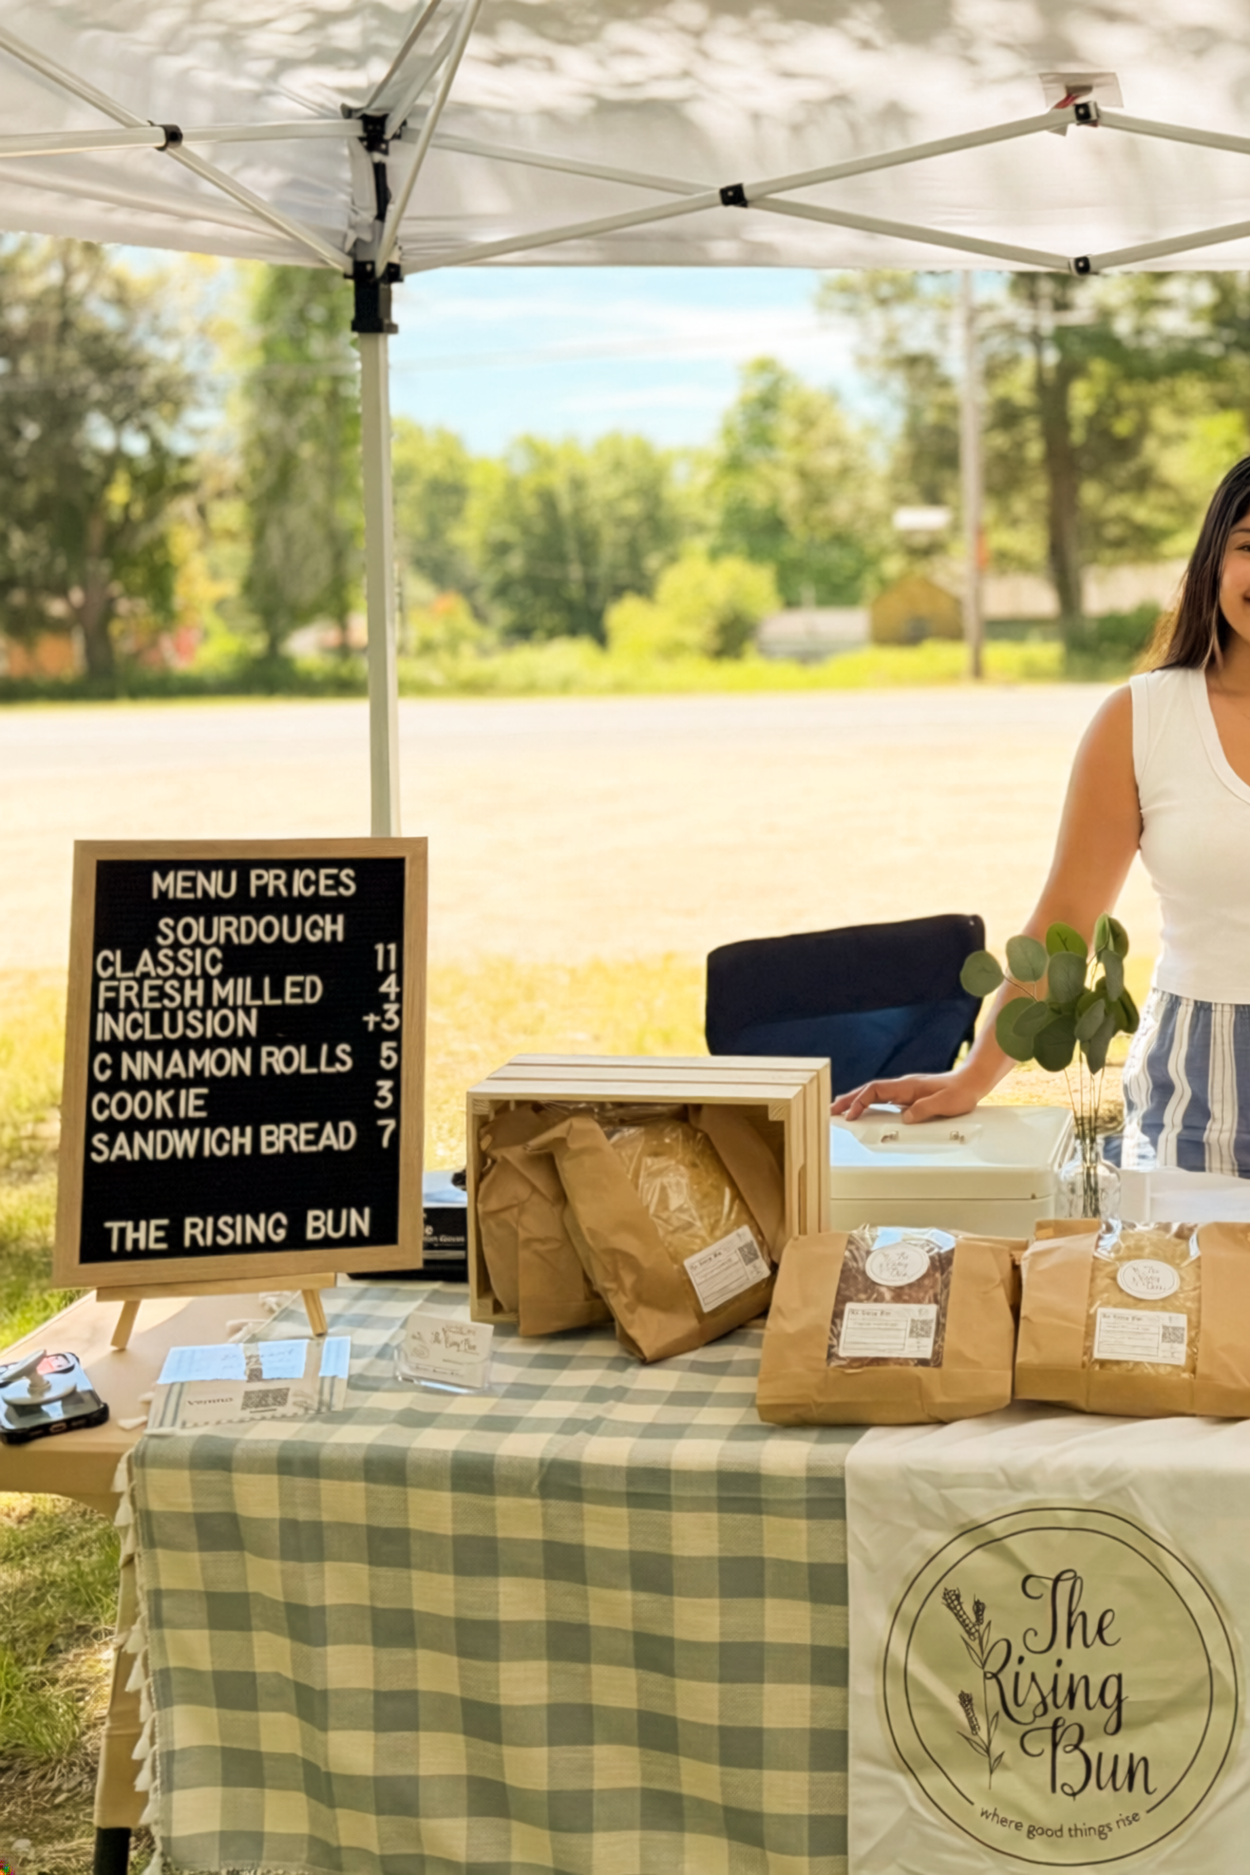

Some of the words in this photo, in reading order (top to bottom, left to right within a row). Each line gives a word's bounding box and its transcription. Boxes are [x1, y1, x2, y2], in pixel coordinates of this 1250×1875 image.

[152, 869, 237, 899] MENU
[250, 868, 357, 898] PRICES
[156, 914, 344, 946] SOURDOUGH
[95, 947, 223, 978] CLASSIC
[374, 943, 397, 971] 11
[98, 978, 205, 1010] FRESH
[212, 976, 323, 1007] MILLED
[378, 973, 400, 1000] 4
[95, 1008, 258, 1041] INCLUSION
[362, 1003, 400, 1032] +3
[260, 1043, 353, 1076] ROLLS
[379, 1041, 399, 1070] 5
[91, 1088, 209, 1122] COOKIE
[374, 1079, 394, 1109] 3
[90, 1126, 252, 1163] SANDWICH
[260, 1121, 357, 1155] BREAD
[376, 1119, 396, 1149] 7
[103, 1219, 170, 1252] THE
[183, 1212, 288, 1248] RISING
[306, 1207, 370, 1240] BUN
[1021, 1569, 1121, 1654] The
[983, 1638, 1128, 1735] Rising
[1019, 1716, 1157, 1800] Bun
[980, 1807, 1023, 1831] where
[1026, 1823, 1063, 1840] good
[1068, 1823, 1113, 1840] things
[1115, 1812, 1140, 1829] rise
